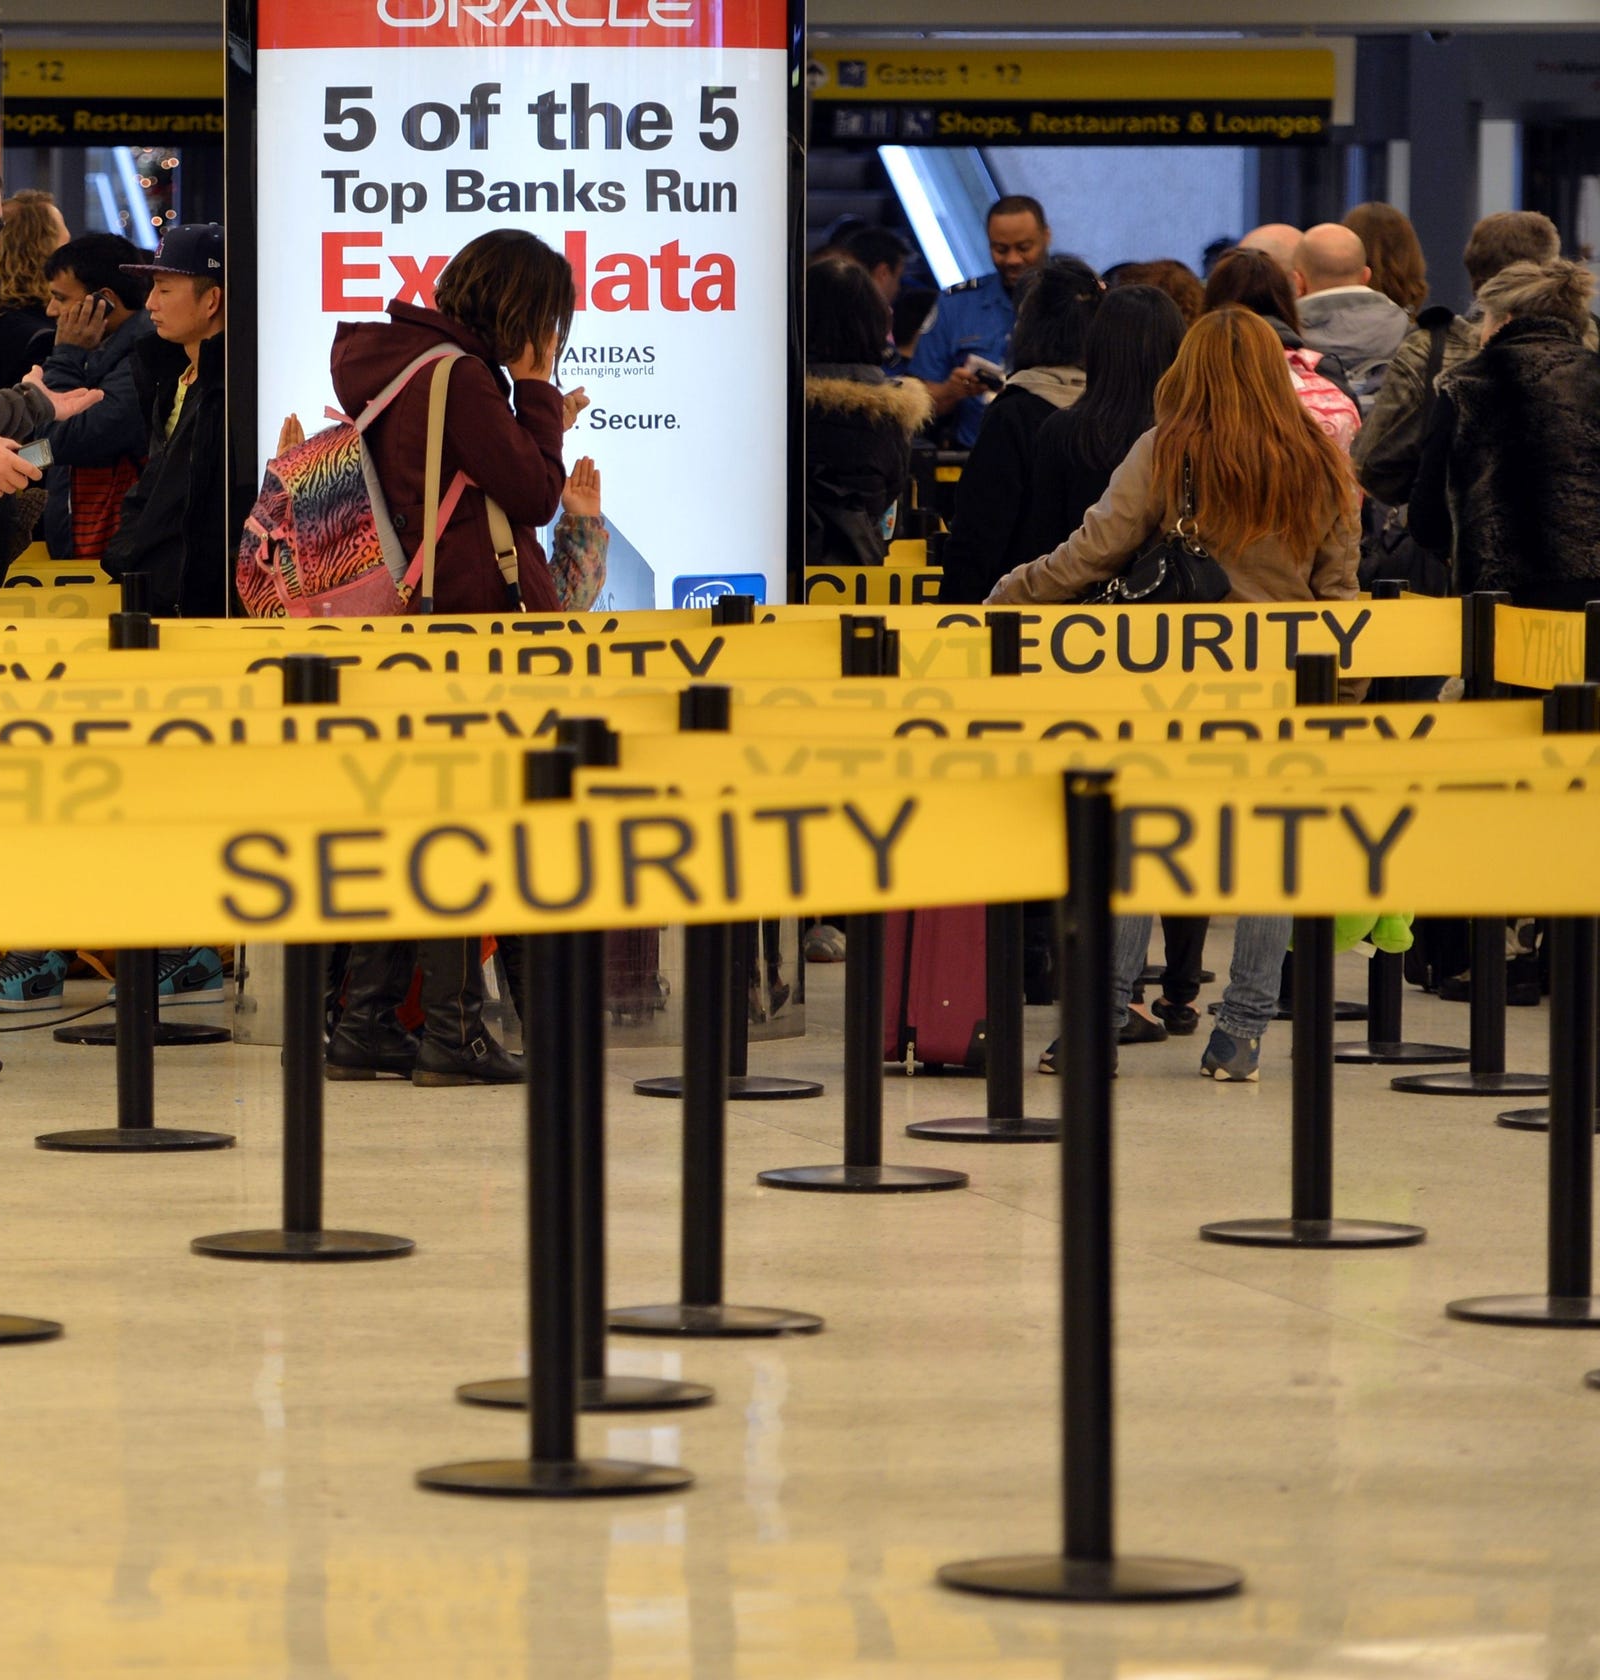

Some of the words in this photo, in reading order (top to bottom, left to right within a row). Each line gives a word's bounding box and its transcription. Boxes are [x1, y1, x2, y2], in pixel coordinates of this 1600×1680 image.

[38, 60, 65, 81] 12
[876, 63, 948, 84] Gates
[995, 63, 1022, 84] 12
[323, 85, 377, 152] 5
[401, 82, 501, 151] of
[528, 82, 673, 151] the
[699, 85, 739, 152] 5
[938, 111, 1023, 138] Shops,
[1030, 112, 1180, 134] Restaurants
[1187, 112, 1207, 134] &
[1215, 113, 1322, 136] Lounges
[321, 170, 428, 224] Top
[446, 169, 626, 213] Banks
[645, 169, 738, 213] Run
[321, 230, 737, 313] Exata
[561, 367, 568, 376] a
[570, 365, 621, 379] changing
[623, 365, 655, 376] world
[589, 407, 681, 430] Secure.
[218, 797, 919, 926] SECURITY
